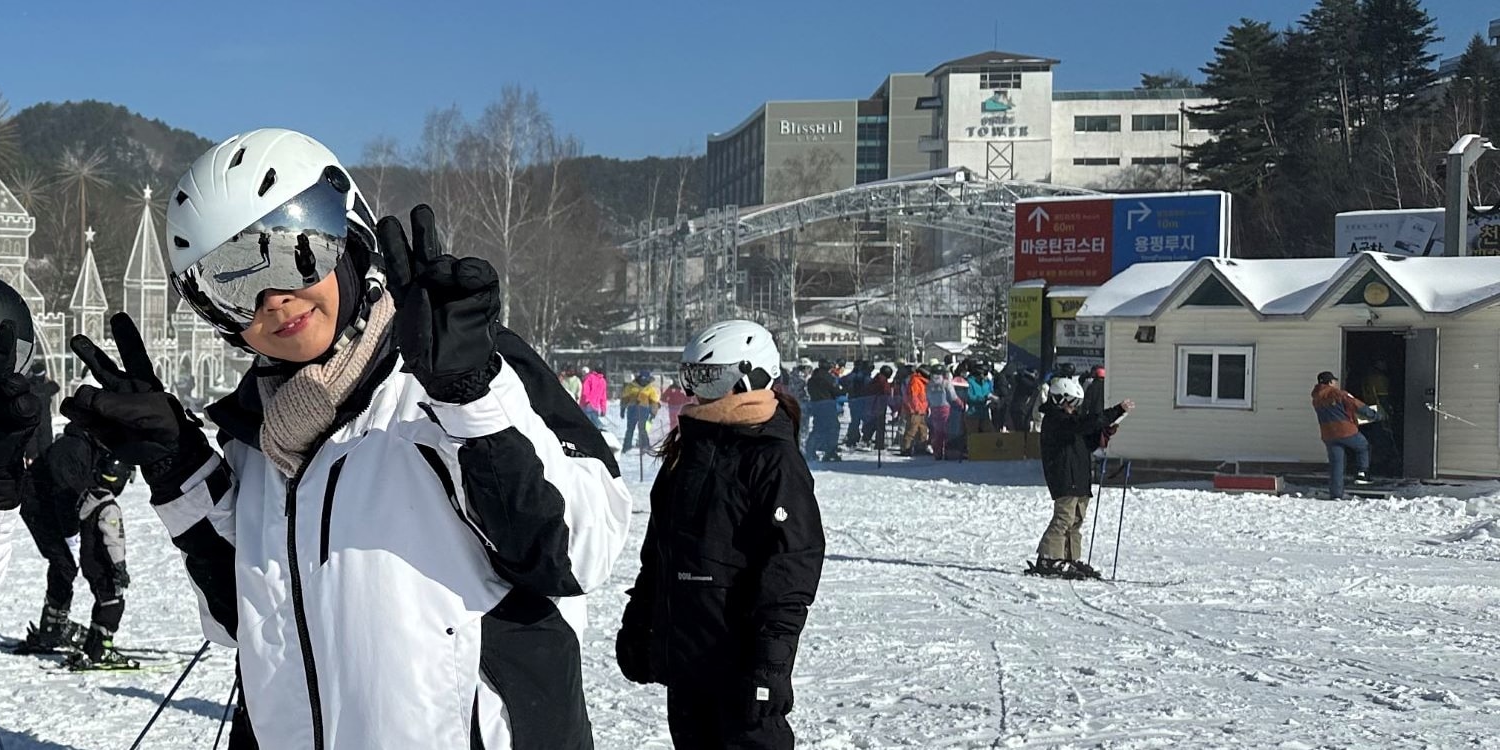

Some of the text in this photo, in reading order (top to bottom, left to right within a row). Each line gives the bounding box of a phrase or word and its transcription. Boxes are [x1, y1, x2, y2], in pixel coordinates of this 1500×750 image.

[965, 126, 1028, 137] TOWER
[1053, 222, 1075, 232] 60m
[1021, 236, 1105, 254] 마운틴코스터
[1134, 234, 1195, 252] 용평루지
[1010, 296, 1038, 304] YELLOW
